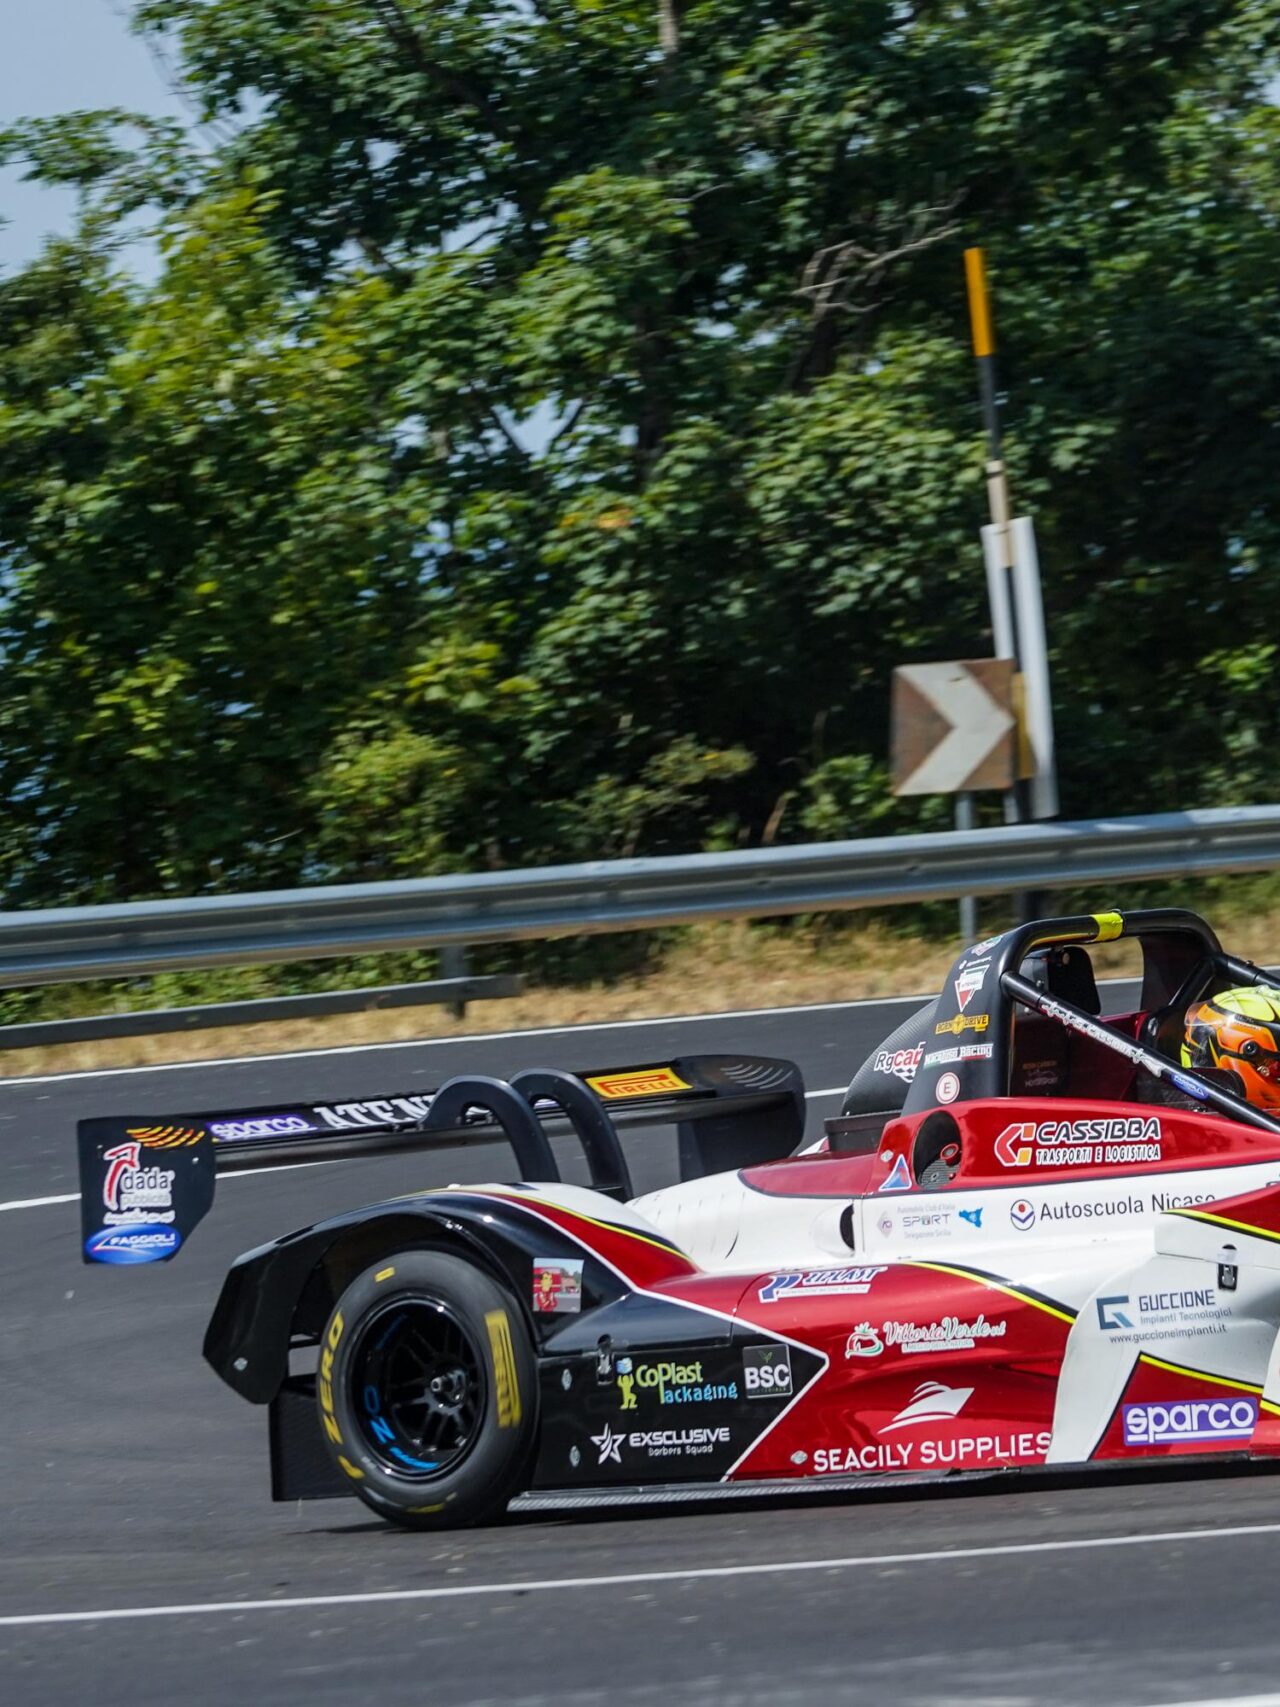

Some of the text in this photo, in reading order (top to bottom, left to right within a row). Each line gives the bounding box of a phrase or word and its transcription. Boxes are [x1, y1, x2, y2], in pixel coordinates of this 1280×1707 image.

[599, 1073, 679, 1096] PIRELLI
[210, 1116, 312, 1141] sparco
[1038, 1118, 1160, 1143] CASSIBBA
[1037, 1145, 1160, 1165] TRASPORTI E LOGISTICA
[123, 1169, 170, 1191] dada
[1040, 1196, 1144, 1221] Autoscuola
[1138, 1289, 1215, 1312] GUCCIONE
[1140, 1307, 1232, 1325] Impianti Tecnologici
[1109, 1323, 1228, 1344] www.guccioneimpianti.it
[744, 1363, 790, 1390] BSC
[1127, 1401, 1255, 1441] sparco
[629, 1427, 731, 1448] EXSCLUSIVE
[685, 1443, 714, 1456] Squad
[813, 1431, 1052, 1472] SEACILY SUPPLIES
